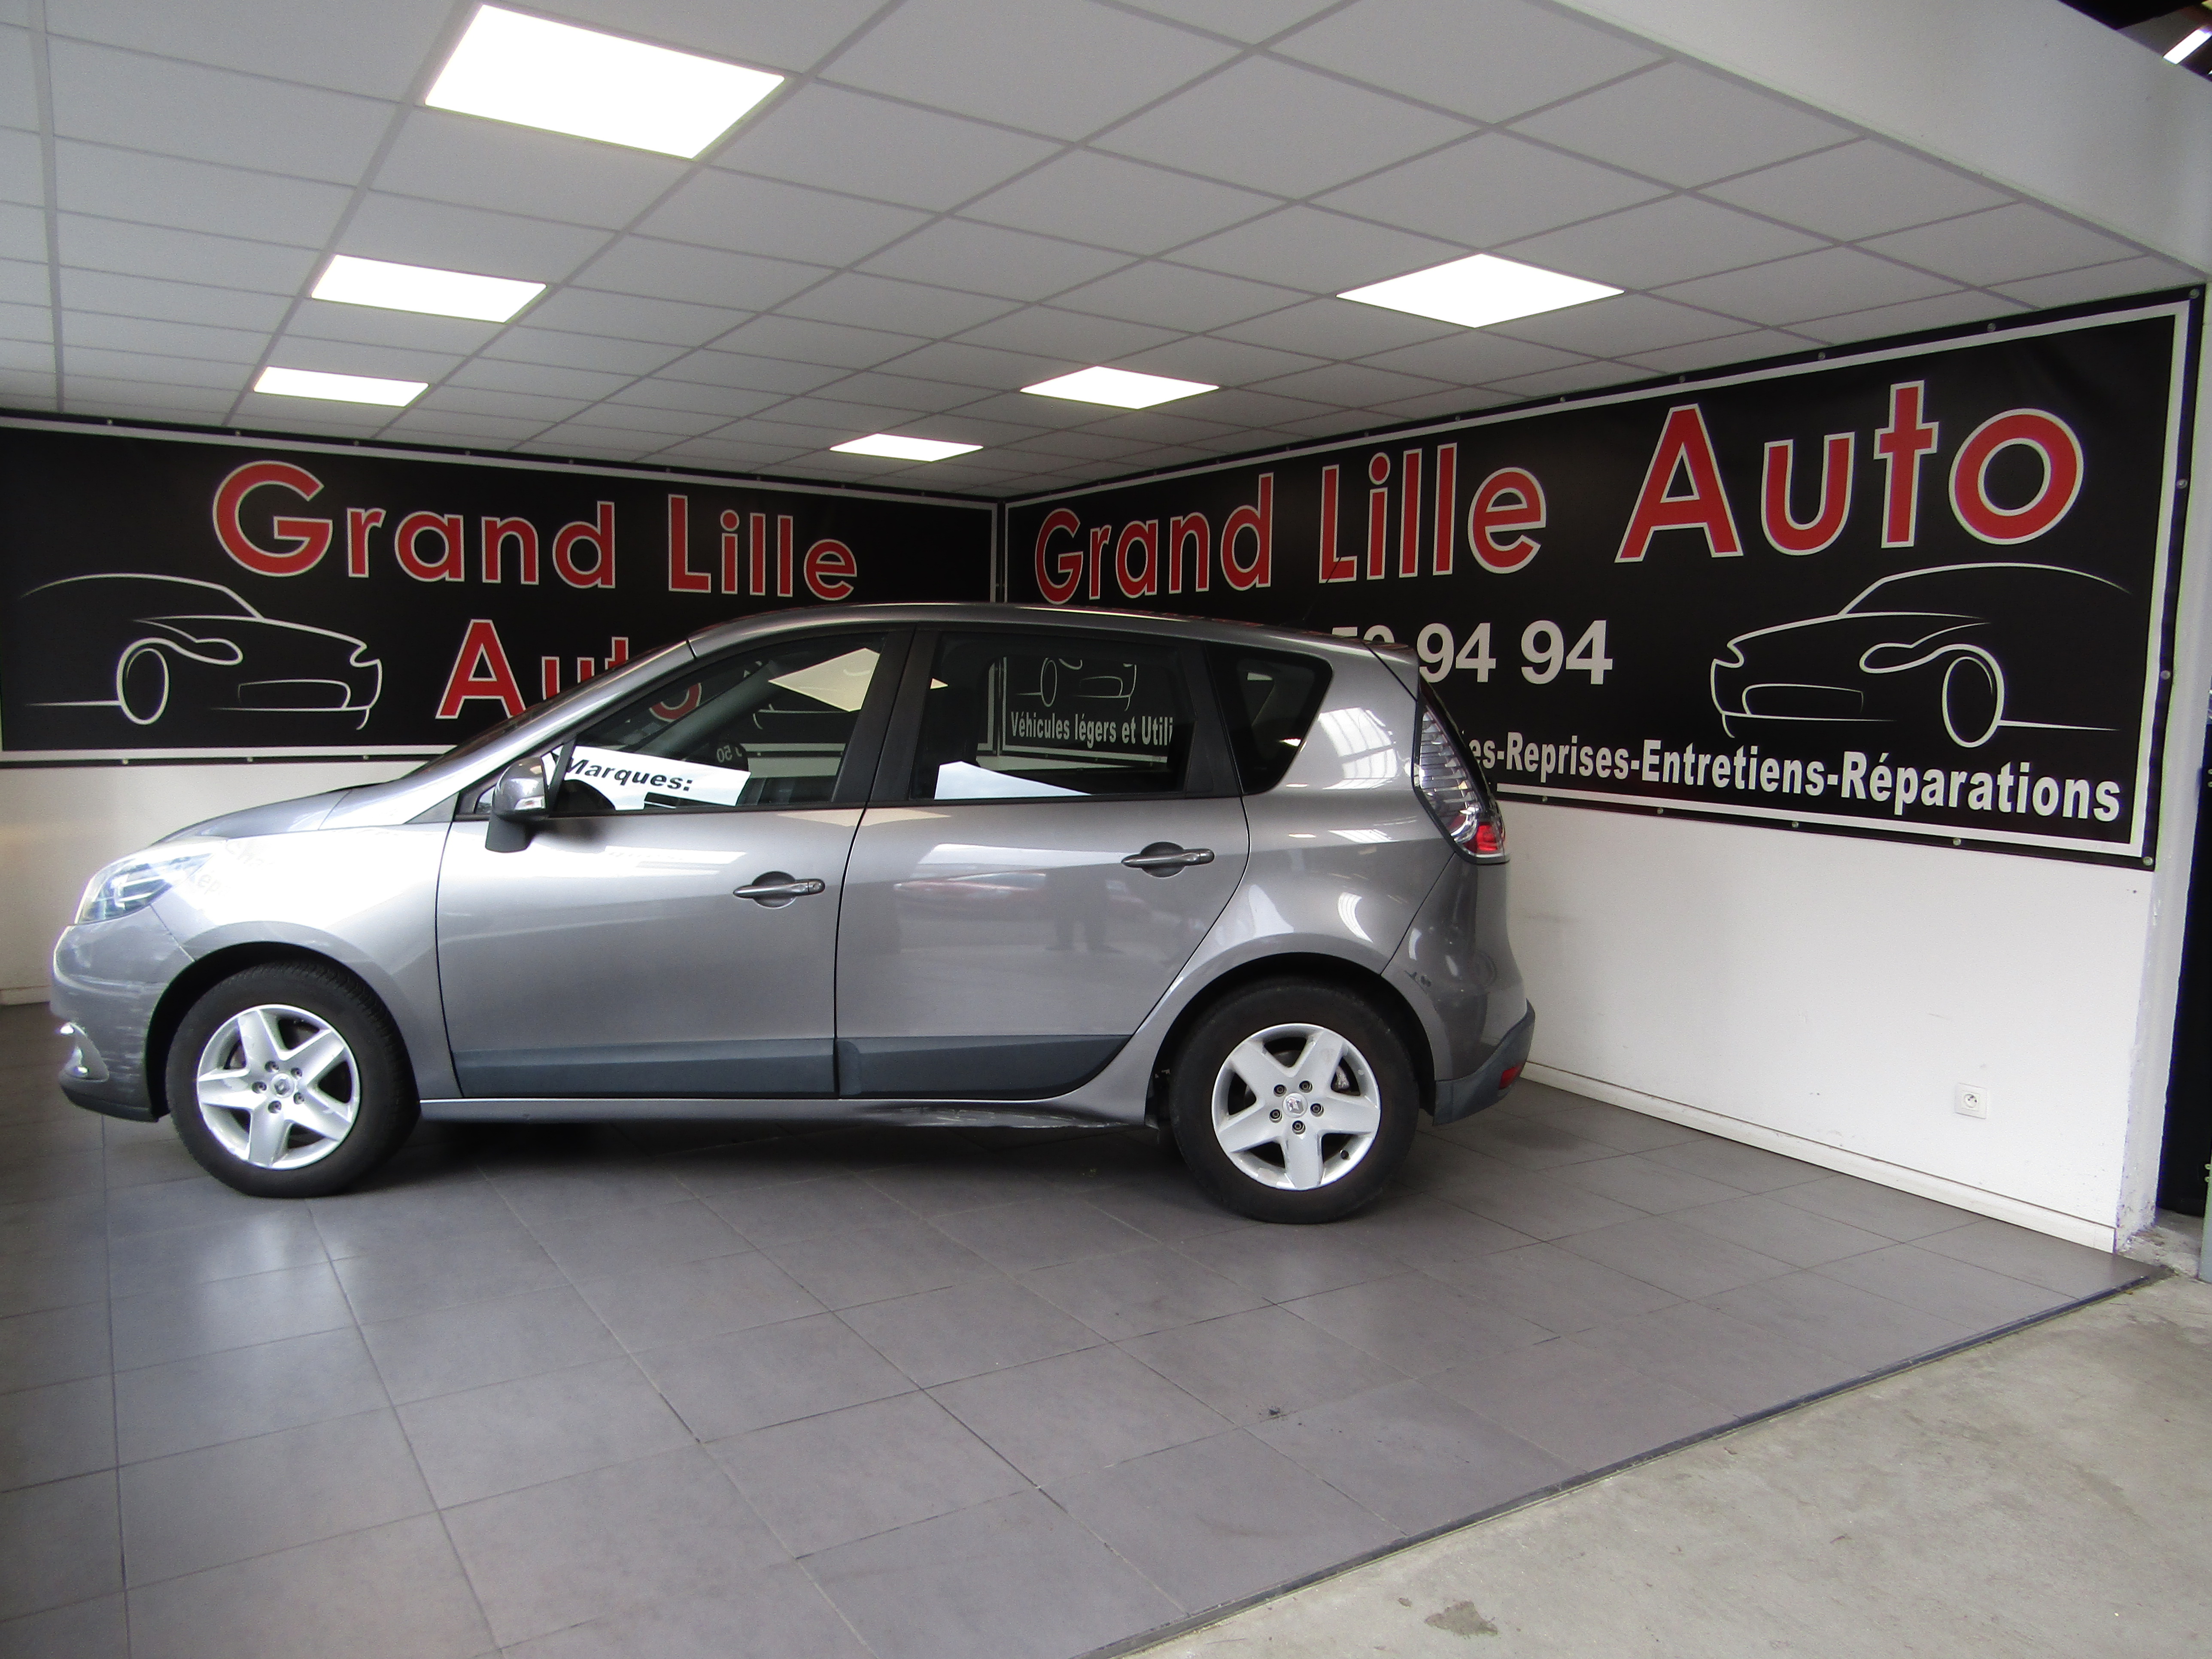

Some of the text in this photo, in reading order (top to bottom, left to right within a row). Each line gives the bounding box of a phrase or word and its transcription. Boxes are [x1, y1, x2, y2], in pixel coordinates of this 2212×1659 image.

[212, 460, 857, 601] Grand Lille
[1034, 380, 2085, 605] Grand Lille Auto
[1417, 620, 1613, 685] 94 94
[1011, 711, 1070, 740] Véhicules
[1075, 713, 1117, 749] légers
[1121, 716, 1136, 744] et
[1462, 729, 2121, 822] es-Reprises-Entretiens-Réparations
